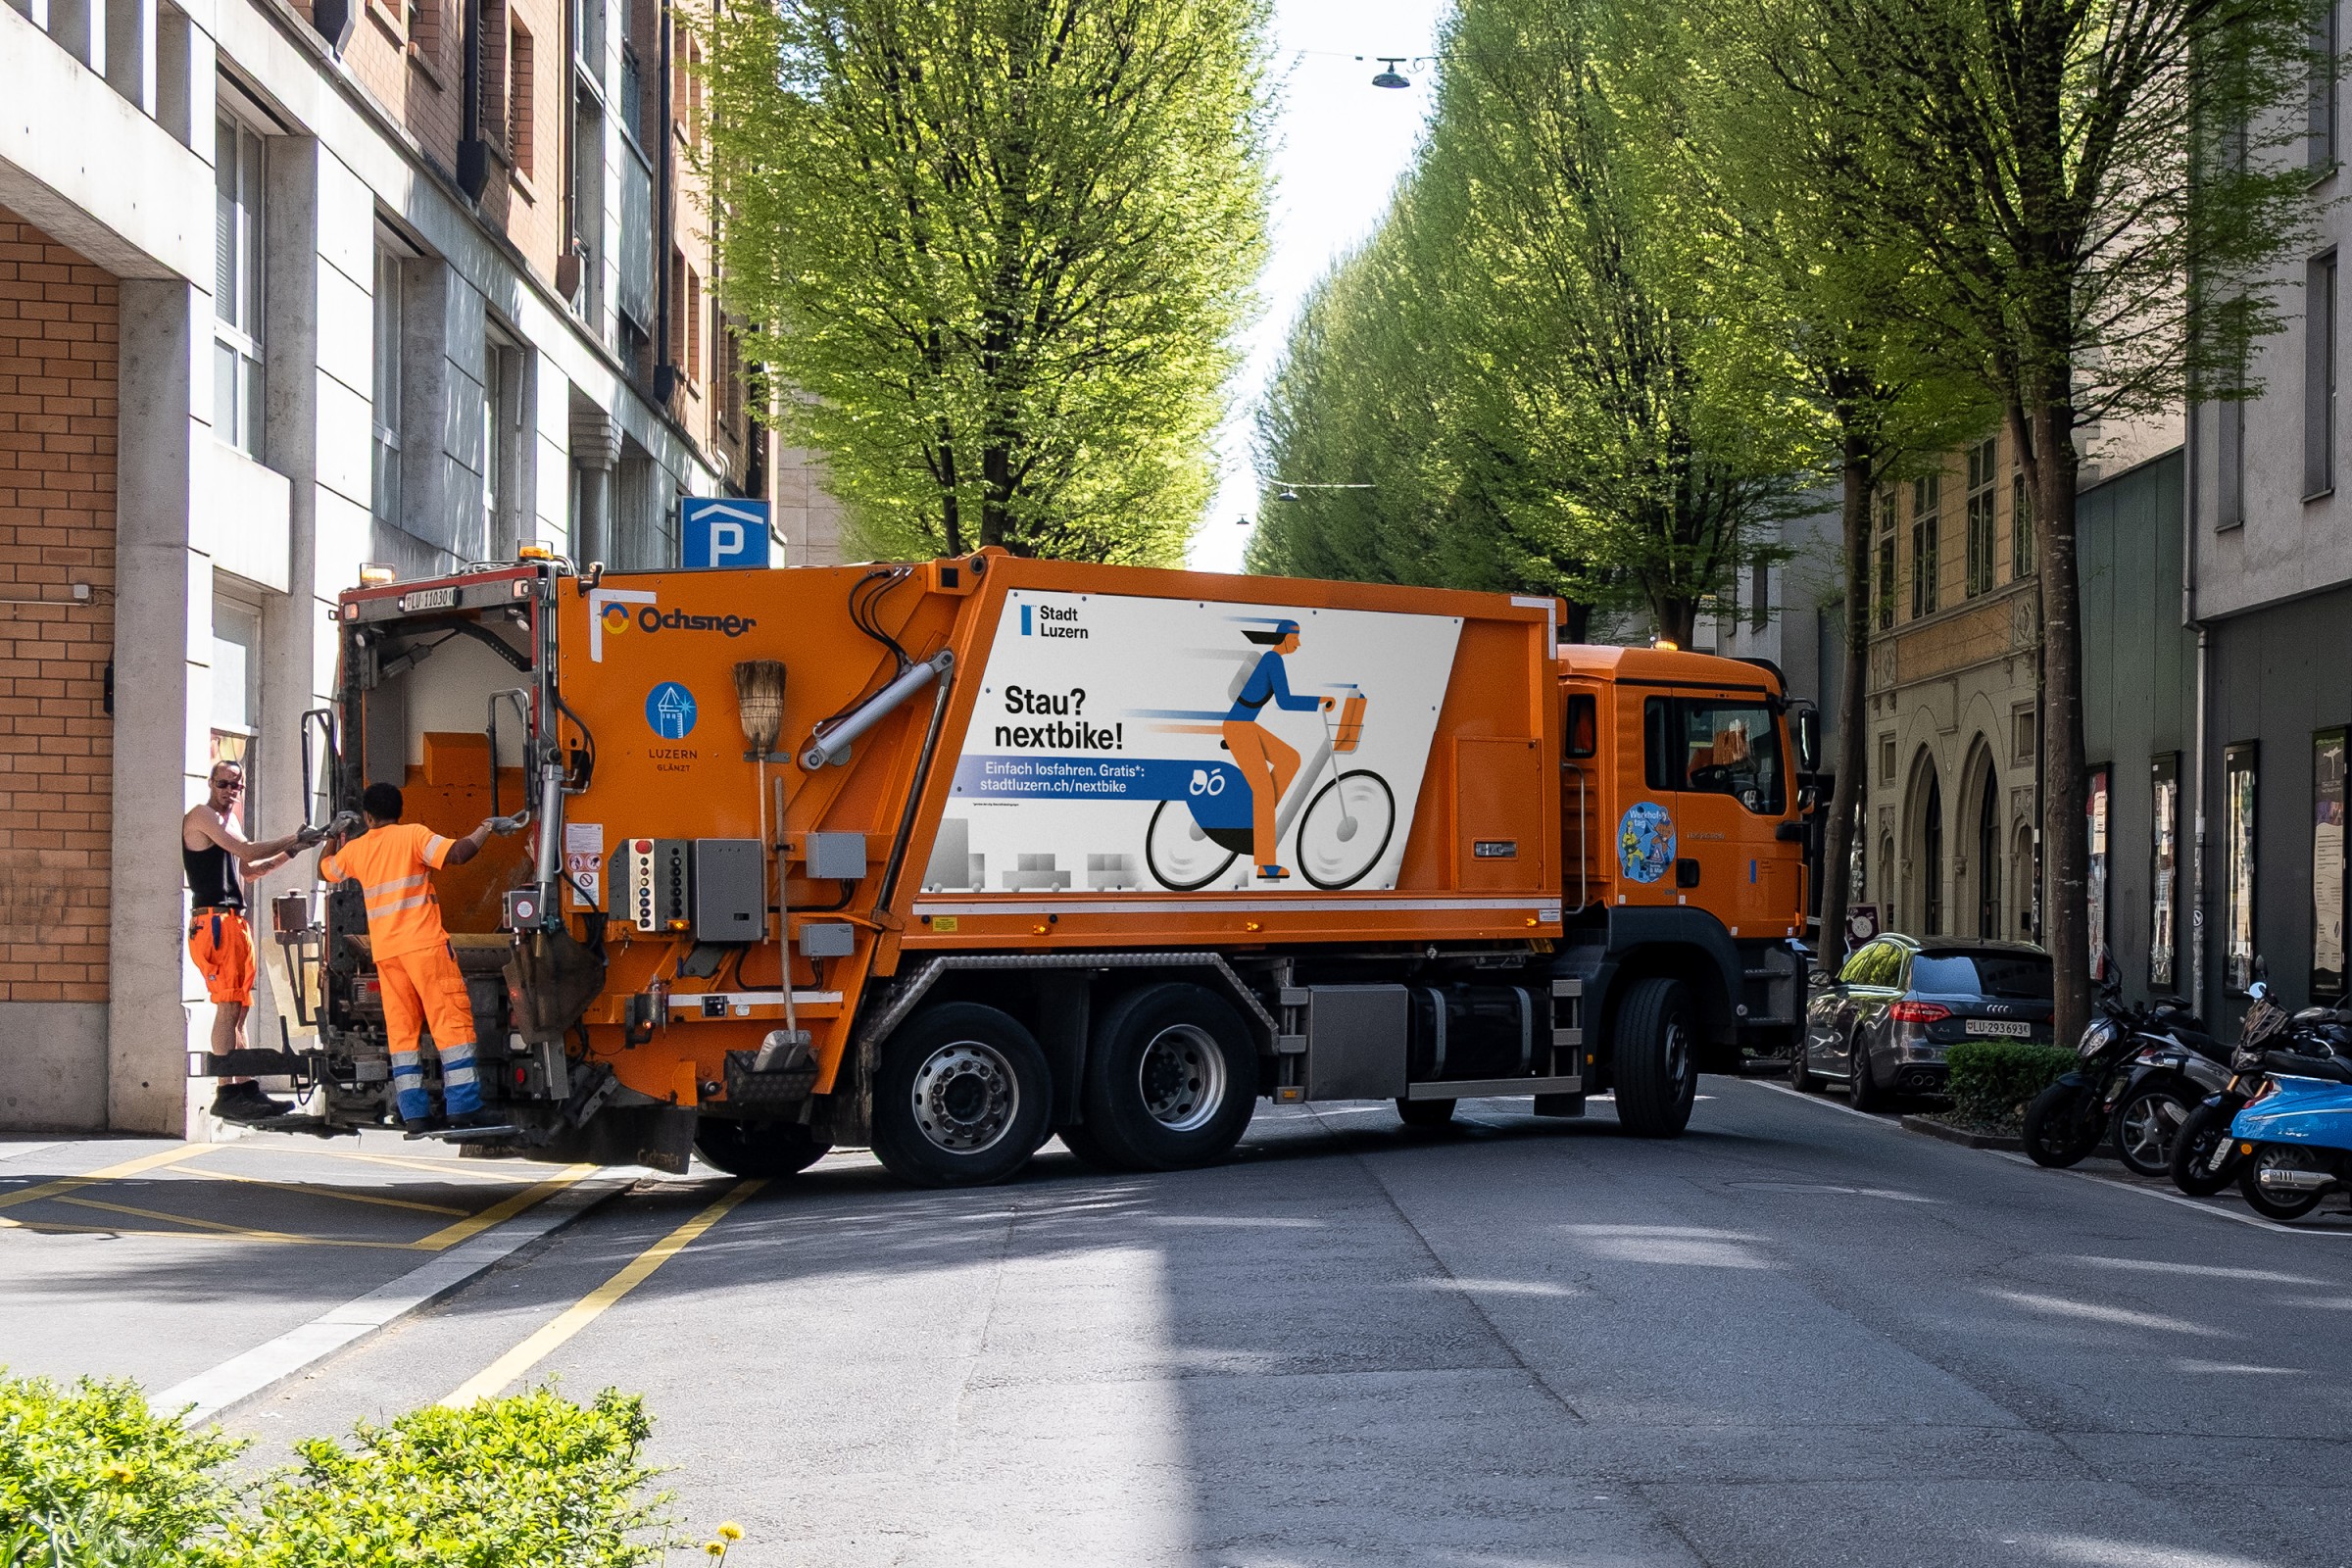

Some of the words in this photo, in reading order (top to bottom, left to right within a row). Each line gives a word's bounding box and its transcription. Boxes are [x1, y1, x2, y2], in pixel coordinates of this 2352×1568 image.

[710, 521, 745, 567] P
[1040, 605, 1078, 621] Stadt
[638, 607, 757, 638] Ochsner
[1040, 622, 1089, 639] Luzern
[1004, 685, 1086, 715] Stau?
[995, 720, 1123, 750] nextbike!
[649, 749, 698, 760] LUZERN
[657, 763, 690, 772] GLÄNZT
[985, 760, 1033, 775] Einfach
[1035, 761, 1097, 776] losfahren.
[980, 777, 1127, 793] stadtluzern.ch/nextbike
[1634, 818, 1646, 829] tag
